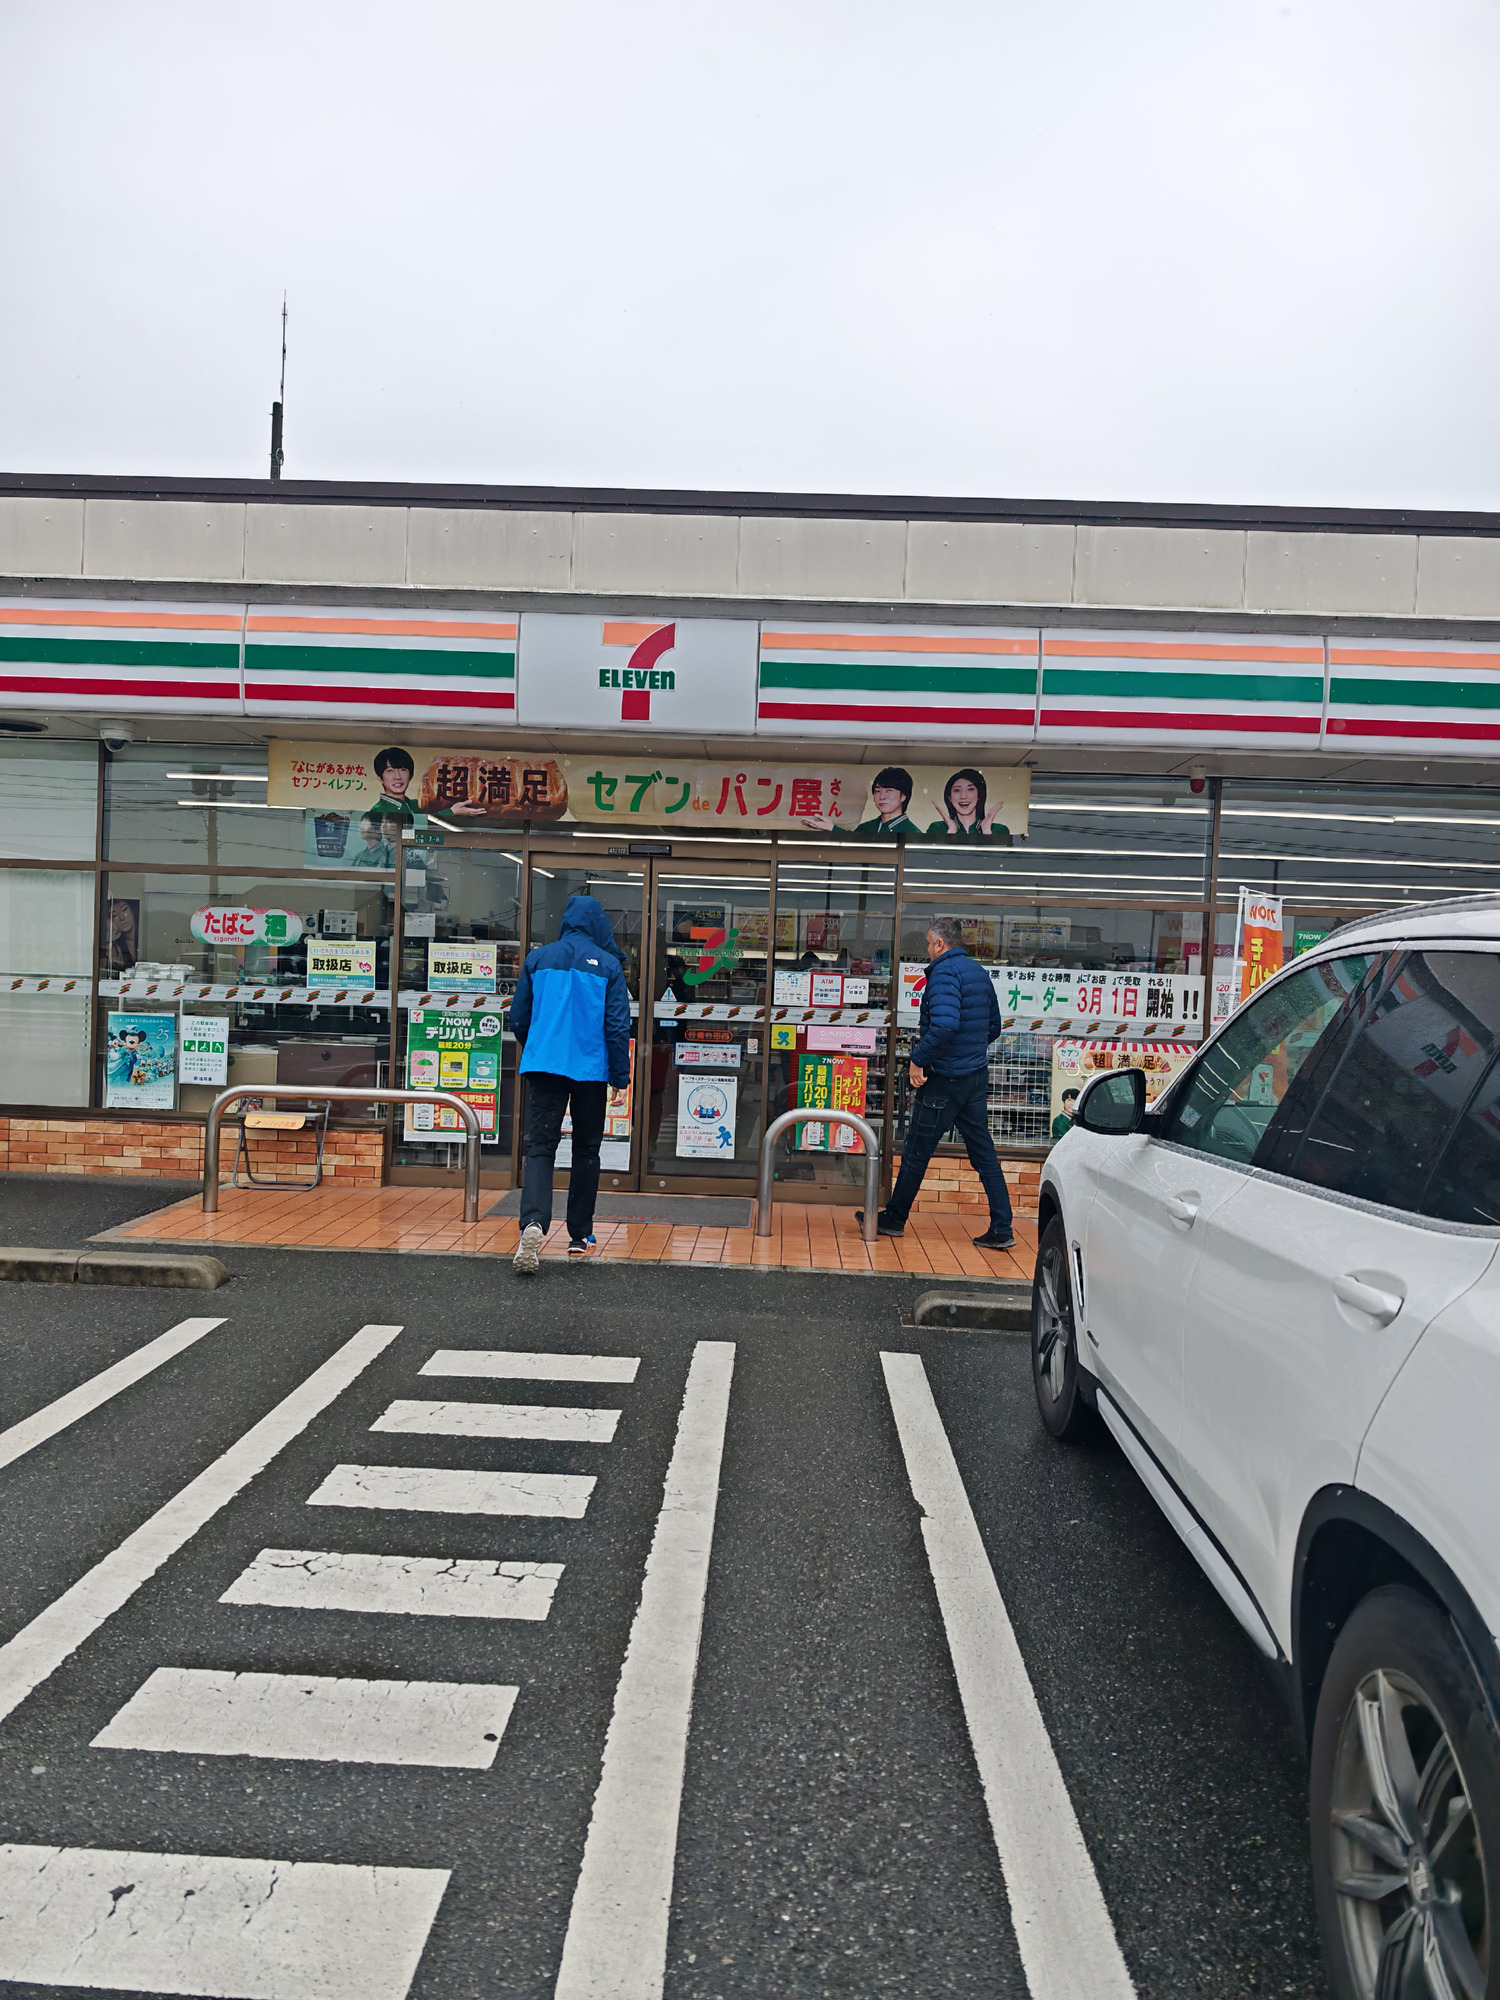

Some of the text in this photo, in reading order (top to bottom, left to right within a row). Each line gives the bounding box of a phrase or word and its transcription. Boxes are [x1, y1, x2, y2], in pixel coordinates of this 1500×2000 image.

[437, 764, 553, 806] 超満足
[204, 911, 288, 938] たばこ 酒
[312, 958, 352, 972] 取扱店
[433, 961, 473, 975] 取扱店
[438, 1017, 472, 1027] 7NOW
[156, 1028, 169, 1041] 25
[425, 1026, 489, 1041] デリバリー
[820, 1030, 852, 1038] DAISO
[851, 1066, 862, 1107] モバイル
